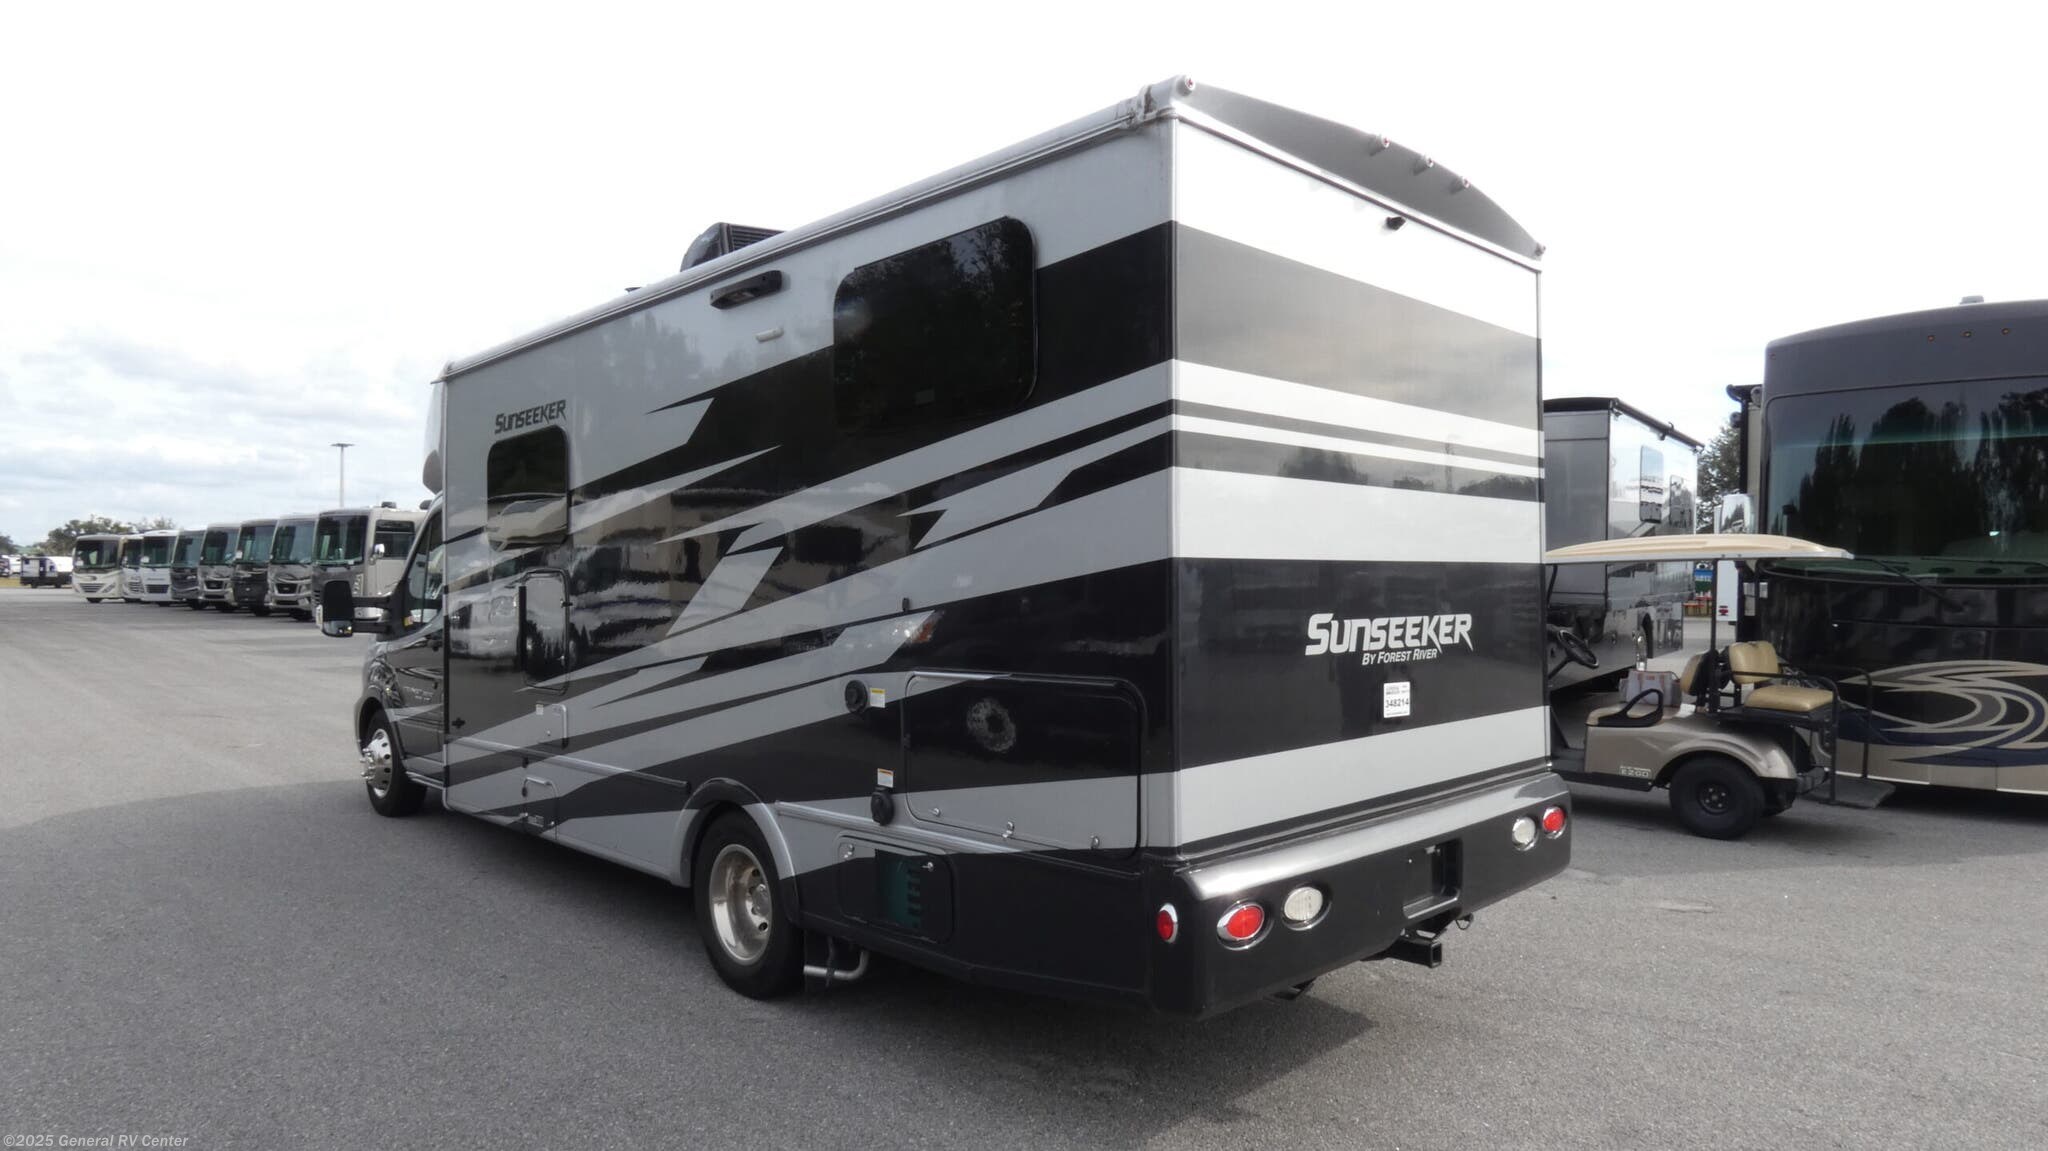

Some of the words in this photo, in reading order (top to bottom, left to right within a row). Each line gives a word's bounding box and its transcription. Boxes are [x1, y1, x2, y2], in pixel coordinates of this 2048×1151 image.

[494, 399, 567, 435] SUNSEEKER
[1305, 613, 1473, 655] SUNSEEKER
[1361, 652, 1375, 666] BY
[1377, 650, 1411, 664] FOREST
[1413, 648, 1438, 661] RIVER
[1385, 698, 1410, 709] 348214
